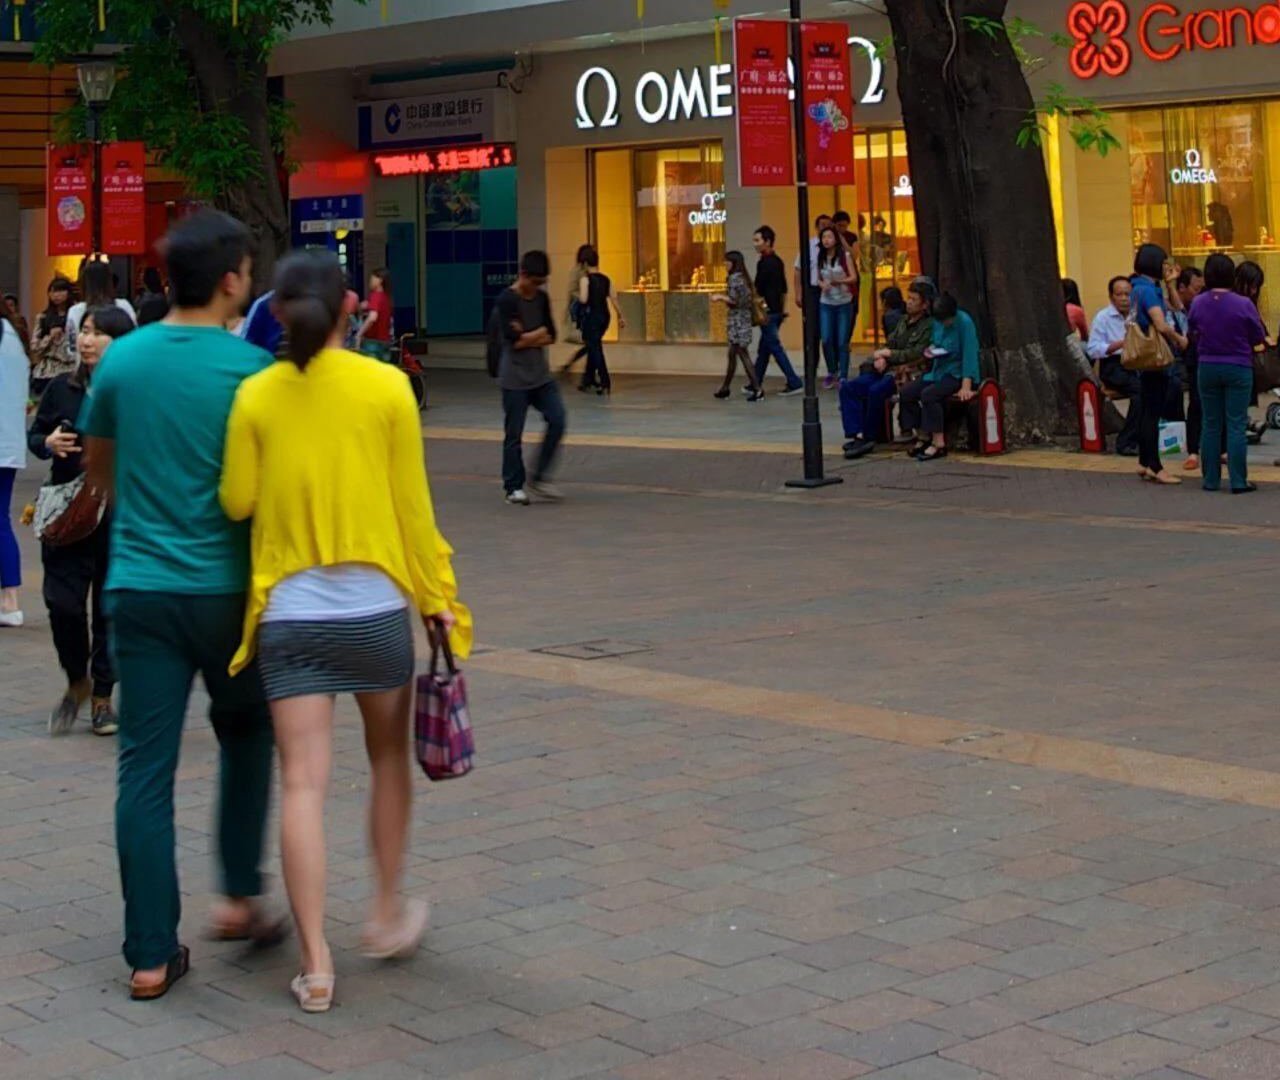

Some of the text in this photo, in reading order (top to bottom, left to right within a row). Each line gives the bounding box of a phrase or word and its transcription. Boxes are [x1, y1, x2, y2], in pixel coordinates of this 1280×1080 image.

[406, 97, 484, 120] 中国建设银行
[1170, 168, 1218, 185] OMEGA
[688, 210, 727, 225] OMEGA
